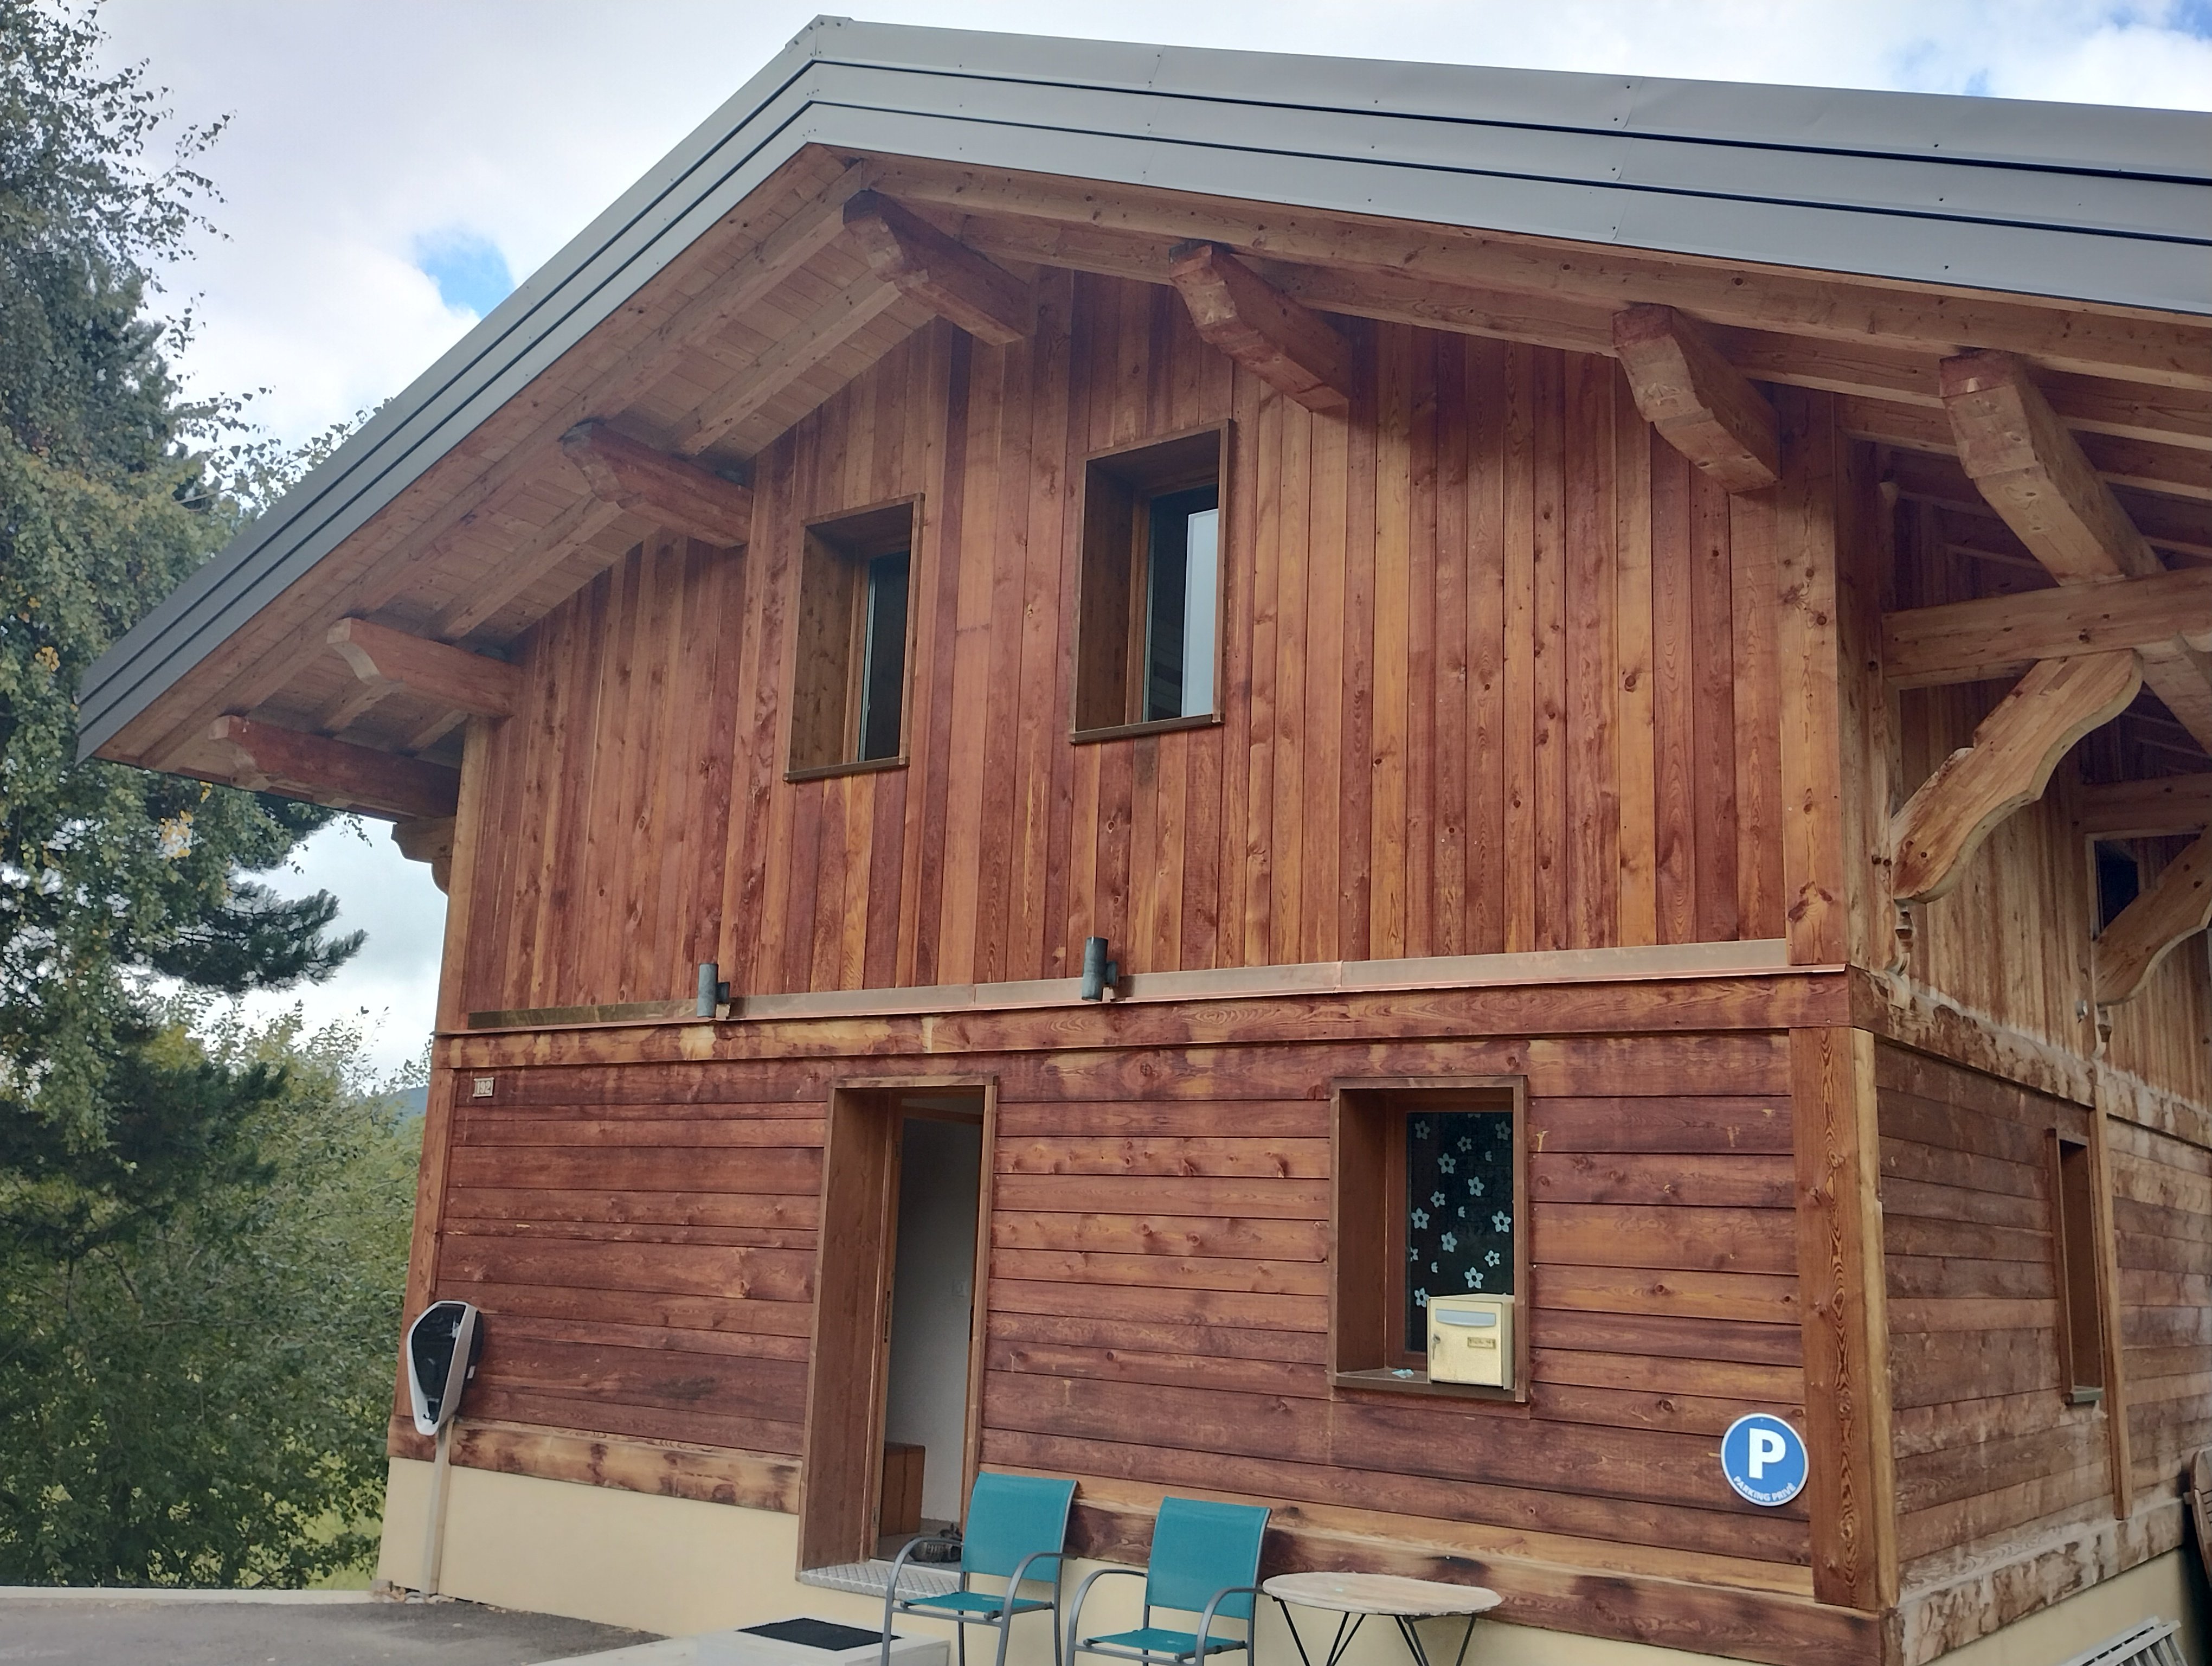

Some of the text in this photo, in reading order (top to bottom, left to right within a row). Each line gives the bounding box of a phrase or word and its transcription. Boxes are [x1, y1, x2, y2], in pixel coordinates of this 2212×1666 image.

[477, 1081, 491, 1094] 192
[1749, 1427, 1786, 1479] P
[1734, 1476, 1771, 1501] PARKING
